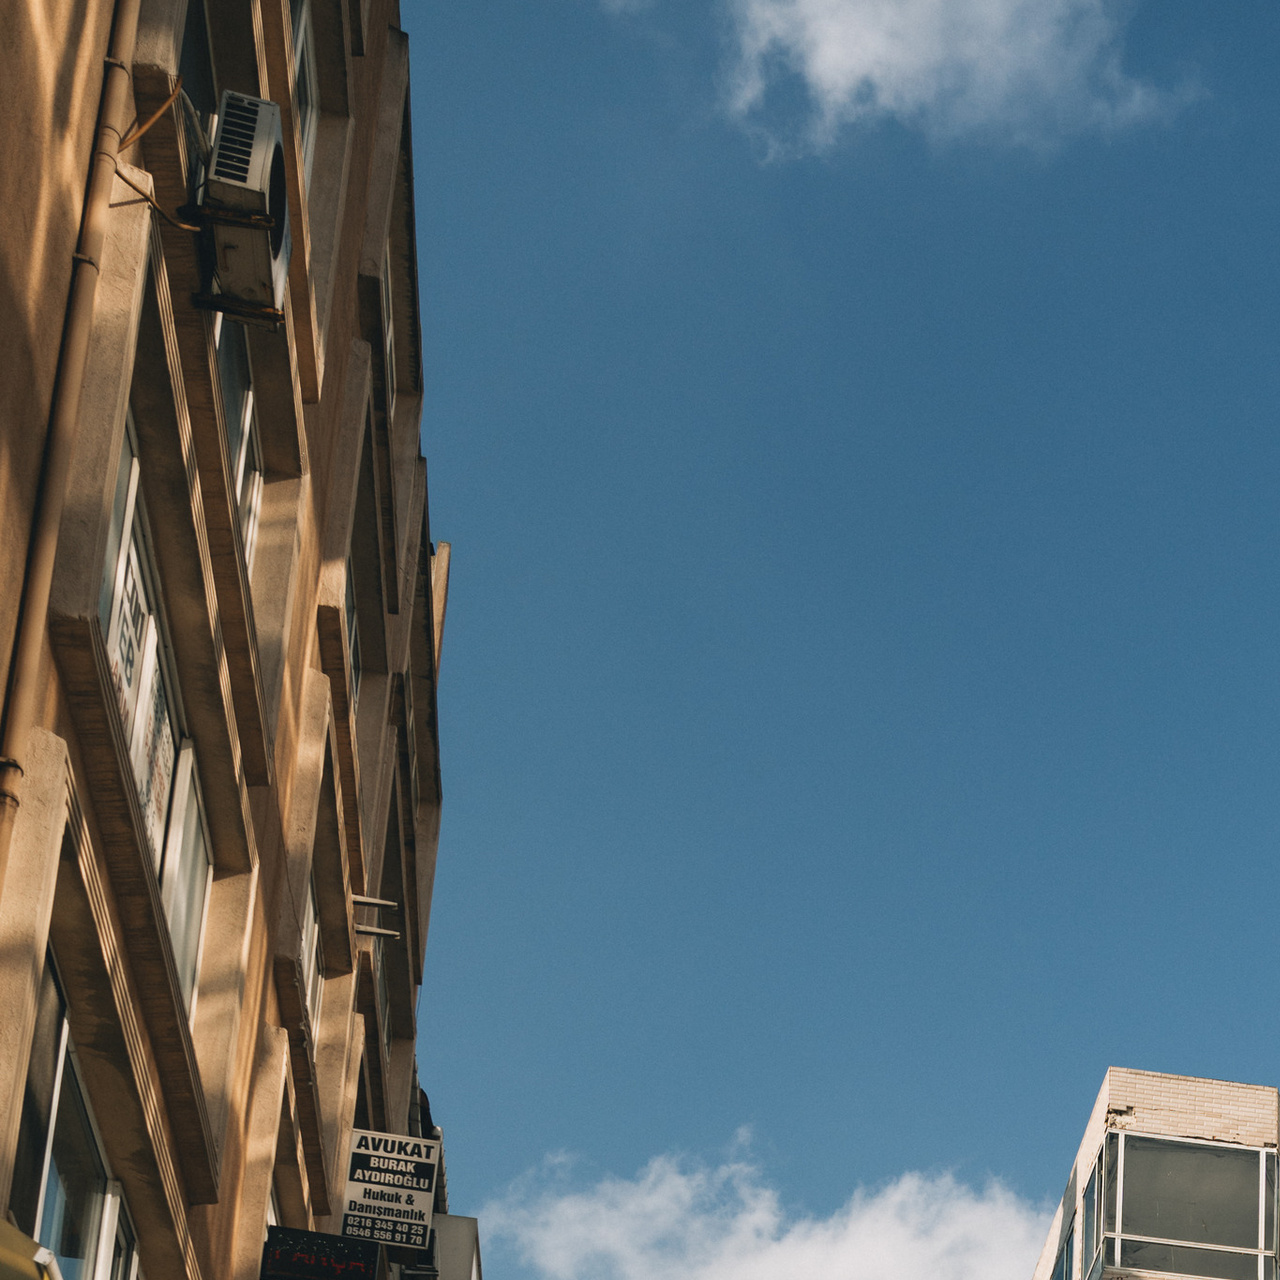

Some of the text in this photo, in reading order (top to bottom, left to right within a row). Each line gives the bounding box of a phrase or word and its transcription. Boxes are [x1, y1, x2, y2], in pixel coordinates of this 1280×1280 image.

[357, 1135, 434, 1159] AVUKAT
[370, 1156, 416, 1173] BURAK
[354, 1169, 429, 1189] AYDIROĞLU
[363, 1188, 415, 1205] Hukuk &
[349, 1200, 425, 1222] Danışmanlık
[346, 1226, 422, 1244] 0546 556 91 70
[347, 1216, 424, 1235] 0216 345 40 25
